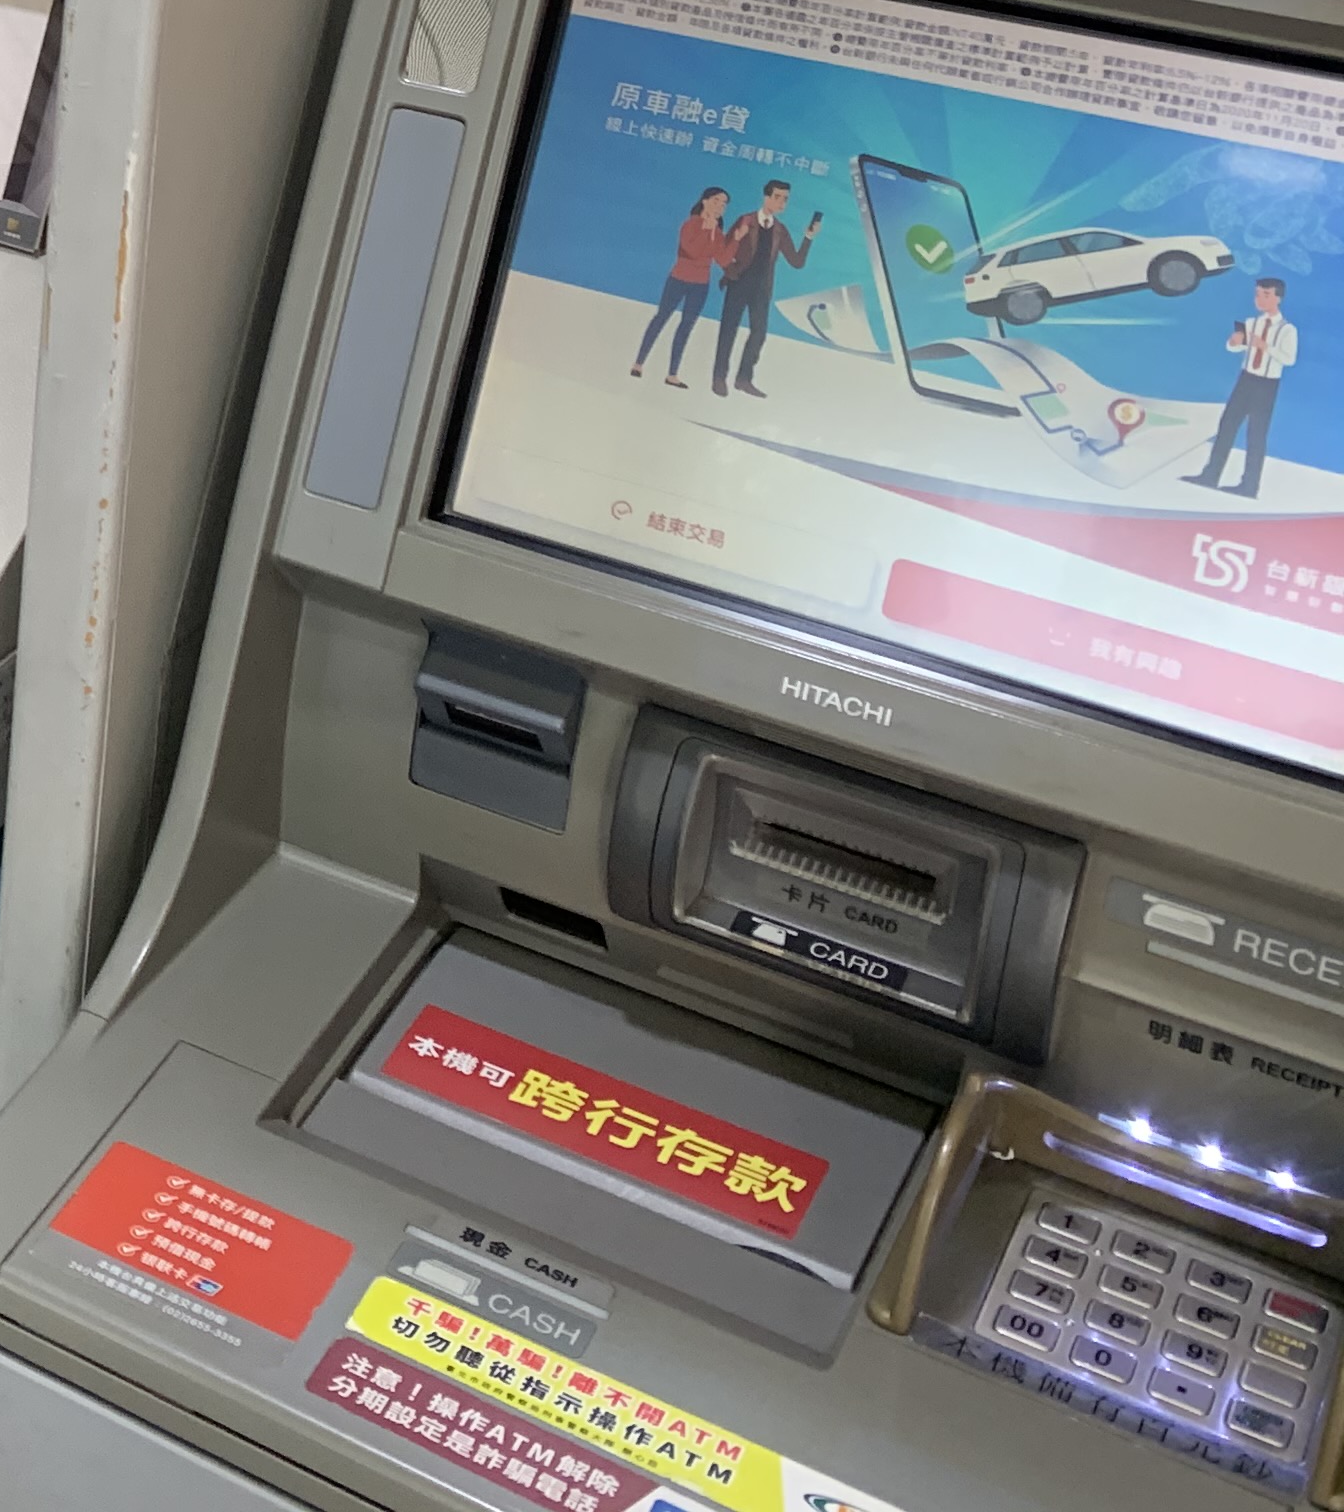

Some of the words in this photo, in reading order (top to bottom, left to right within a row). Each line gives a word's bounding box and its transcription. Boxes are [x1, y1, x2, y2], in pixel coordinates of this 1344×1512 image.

[611, 81, 751, 135] 原車融e貸
[646, 511, 725, 549] 結束交易
[780, 676, 894, 727] HITACHI
[782, 884, 830, 913] 卡片
[843, 905, 899, 934] CARD
[809, 941, 889, 980] CARD
[1148, 1019, 1235, 1066] 明細表
[1250, 1056, 1344, 1098] RECEIPT
[407, 1031, 516, 1089] 本機可
[509, 1065, 810, 1215] 跨行存款
[460, 1225, 513, 1258] 現金
[523, 1254, 581, 1290] CASH
[1064, 1214, 1075, 1229] 1
[1132, 1241, 1151, 1256] 2
[1209, 1271, 1226, 1287] 3
[1045, 1249, 1061, 1263] 4
[1121, 1275, 1139, 1293] 5
[1197, 1306, 1213, 1323] 6
[487, 1290, 584, 1347] CASH
[1009, 1314, 1044, 1339] 00
[1095, 1349, 1112, 1366] 0
[1035, 1282, 1049, 1297] 7
[1108, 1312, 1125, 1329] 8
[1186, 1343, 1202, 1360] 9
